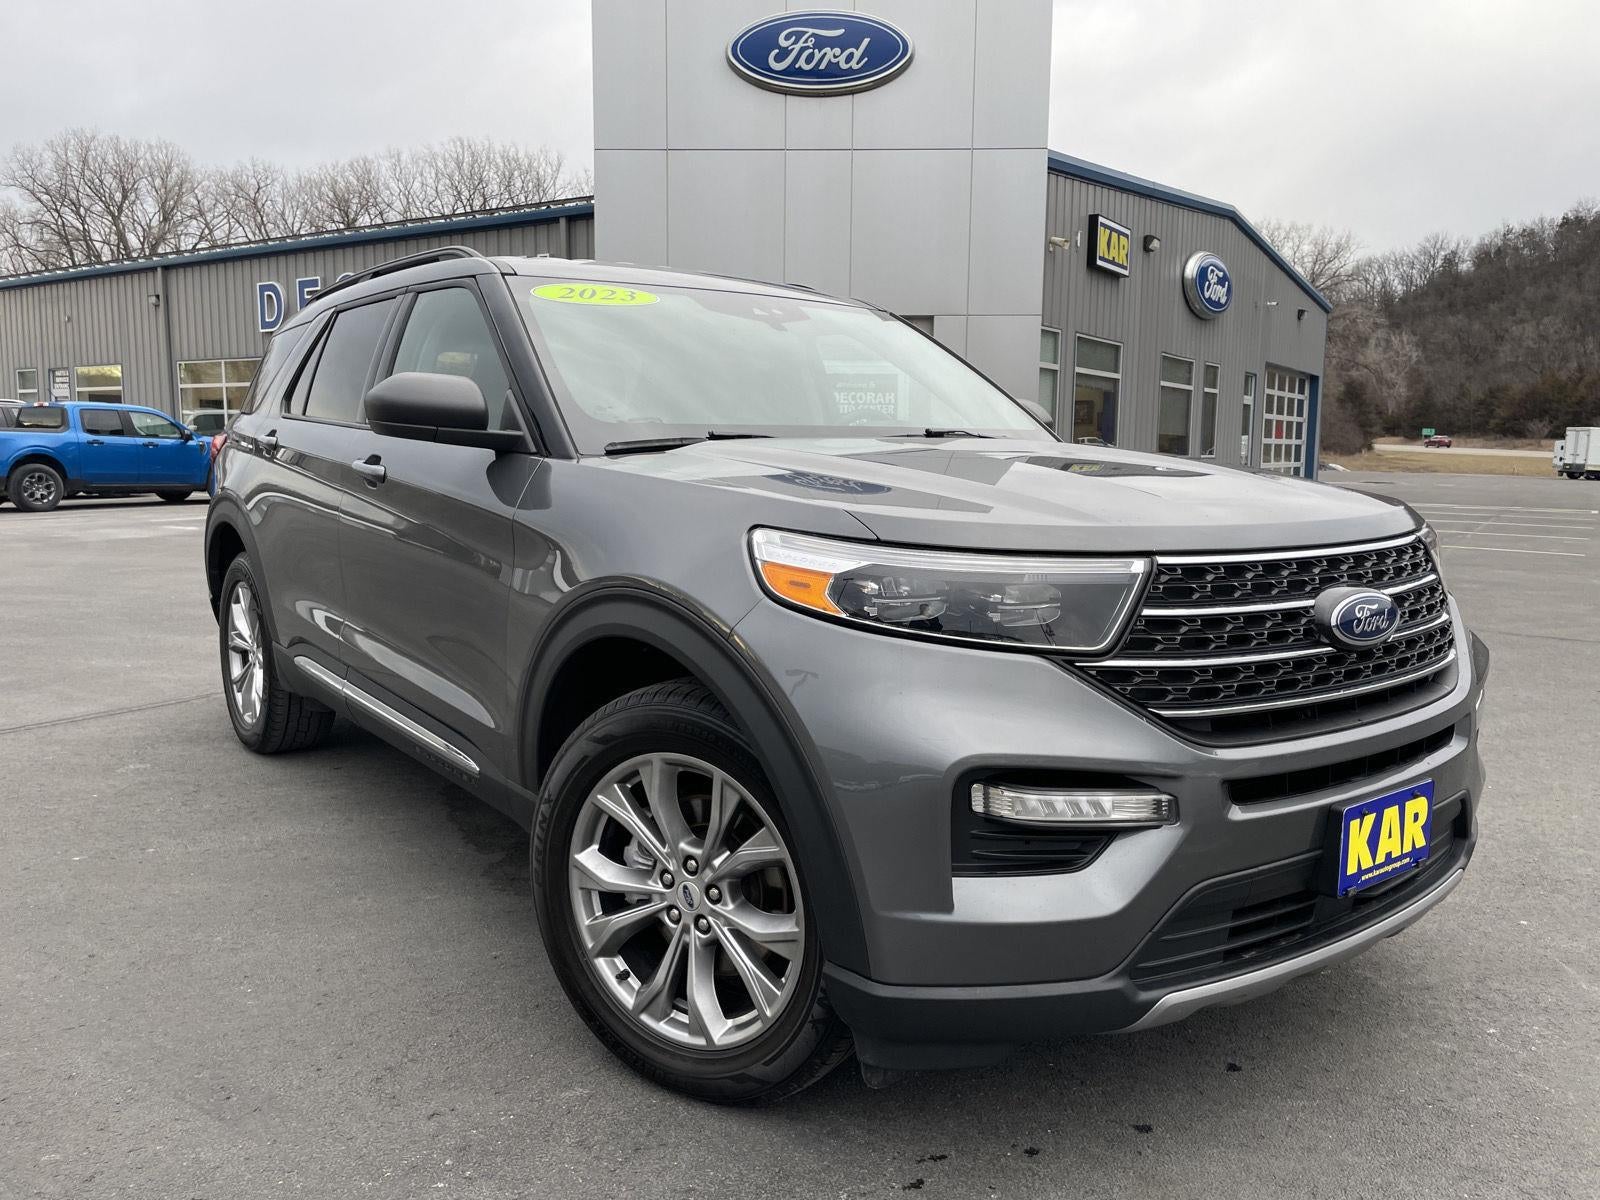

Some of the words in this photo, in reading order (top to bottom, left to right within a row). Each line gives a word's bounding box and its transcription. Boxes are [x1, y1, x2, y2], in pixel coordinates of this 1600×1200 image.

[768, 27, 871, 71] Ford
[1099, 226, 1129, 267] KAR
[257, 272, 355, 333] DE
[558, 287, 637, 302] 2023
[1203, 265, 1229, 305] Ford
[1353, 603, 1390, 634] Ford
[1346, 796, 1429, 876] KAR
